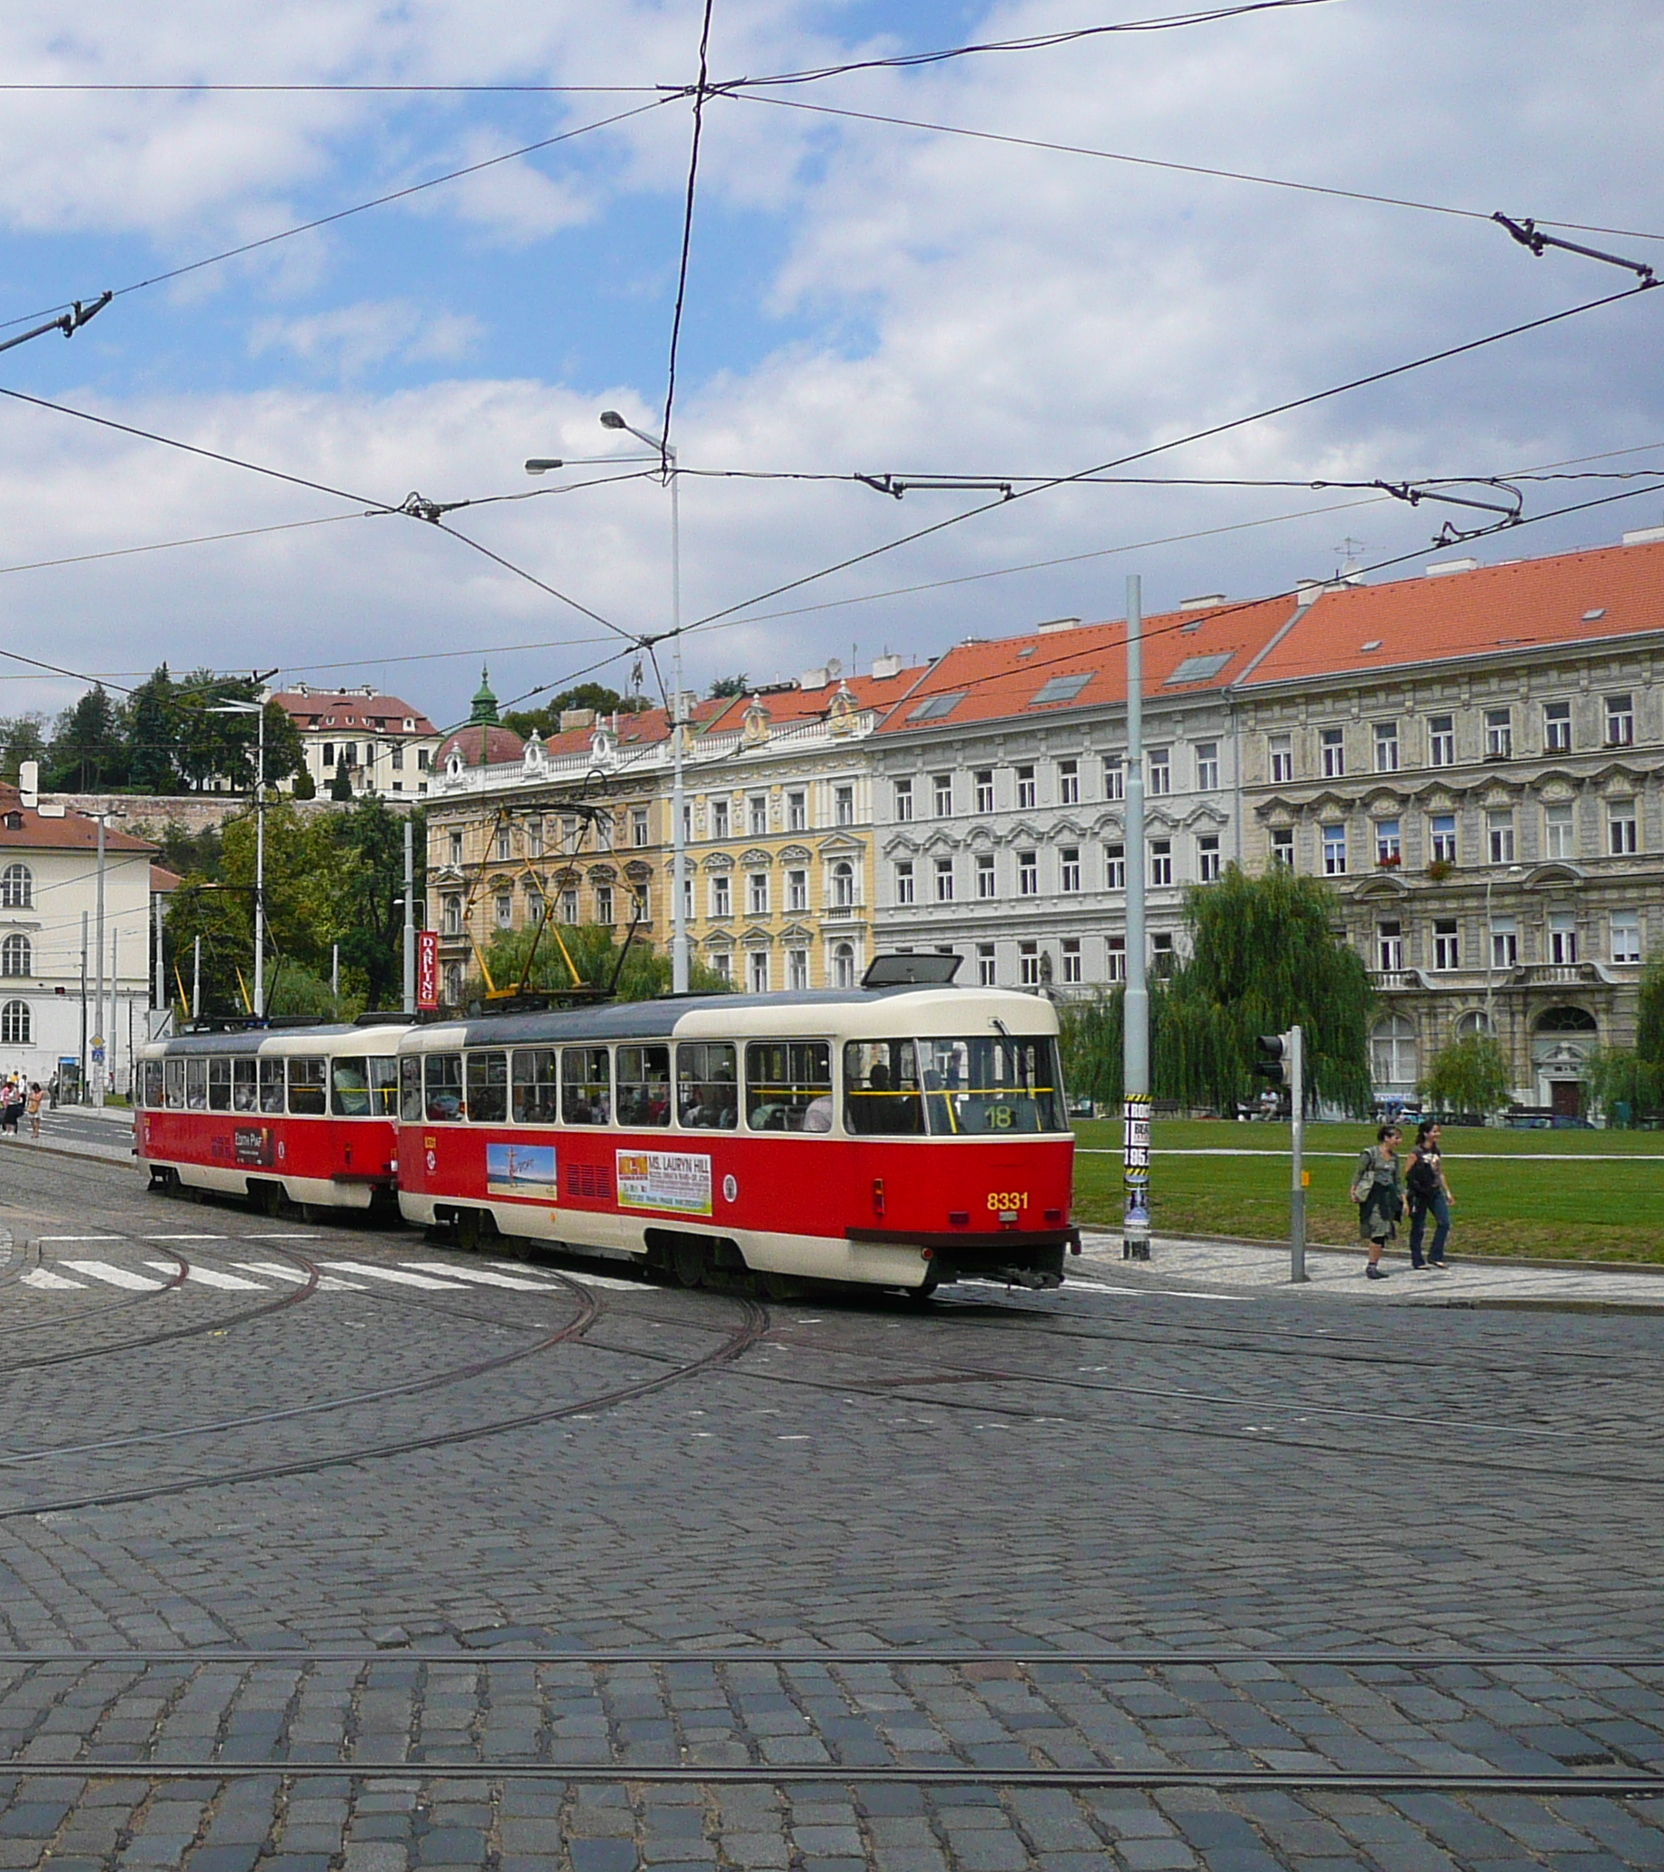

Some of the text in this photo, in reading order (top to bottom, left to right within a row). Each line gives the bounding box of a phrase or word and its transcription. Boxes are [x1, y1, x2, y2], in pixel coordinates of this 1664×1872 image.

[422, 937, 434, 999] DARLING
[984, 1105, 1012, 1128] 18
[649, 1156, 662, 1170] MS.
[663, 1157, 692, 1172] LAURYN
[693, 1159, 710, 1174] HILL
[986, 1191, 1029, 1210] 8331
